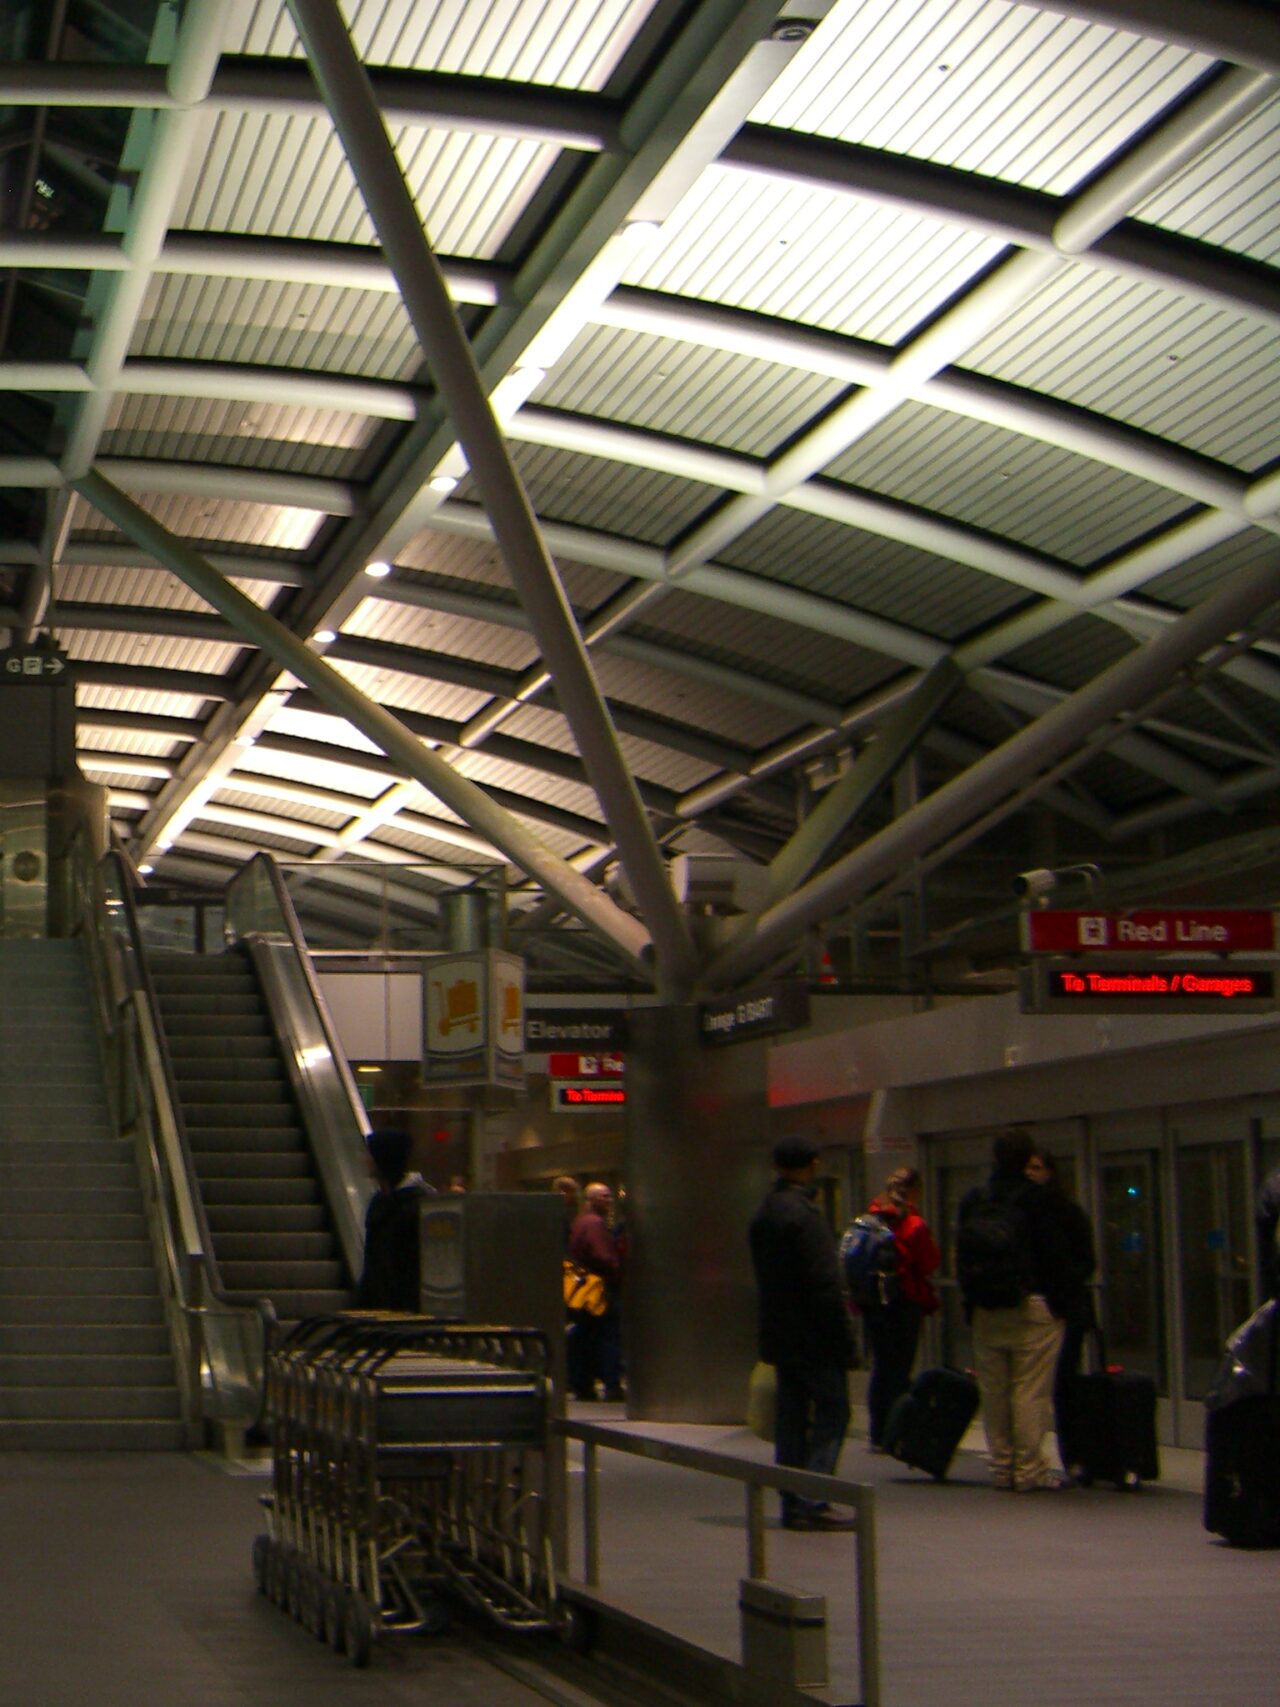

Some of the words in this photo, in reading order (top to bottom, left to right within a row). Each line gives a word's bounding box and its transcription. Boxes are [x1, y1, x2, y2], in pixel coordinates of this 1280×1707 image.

[6, 657, 21, 673] G
[1117, 919, 1168, 942] Red
[1175, 919, 1227, 942] Line
[1060, 973, 1084, 992] To
[1086, 973, 1168, 992] Terminals
[1182, 973, 1253, 997] Garages
[526, 1021, 611, 1038] Elevator
